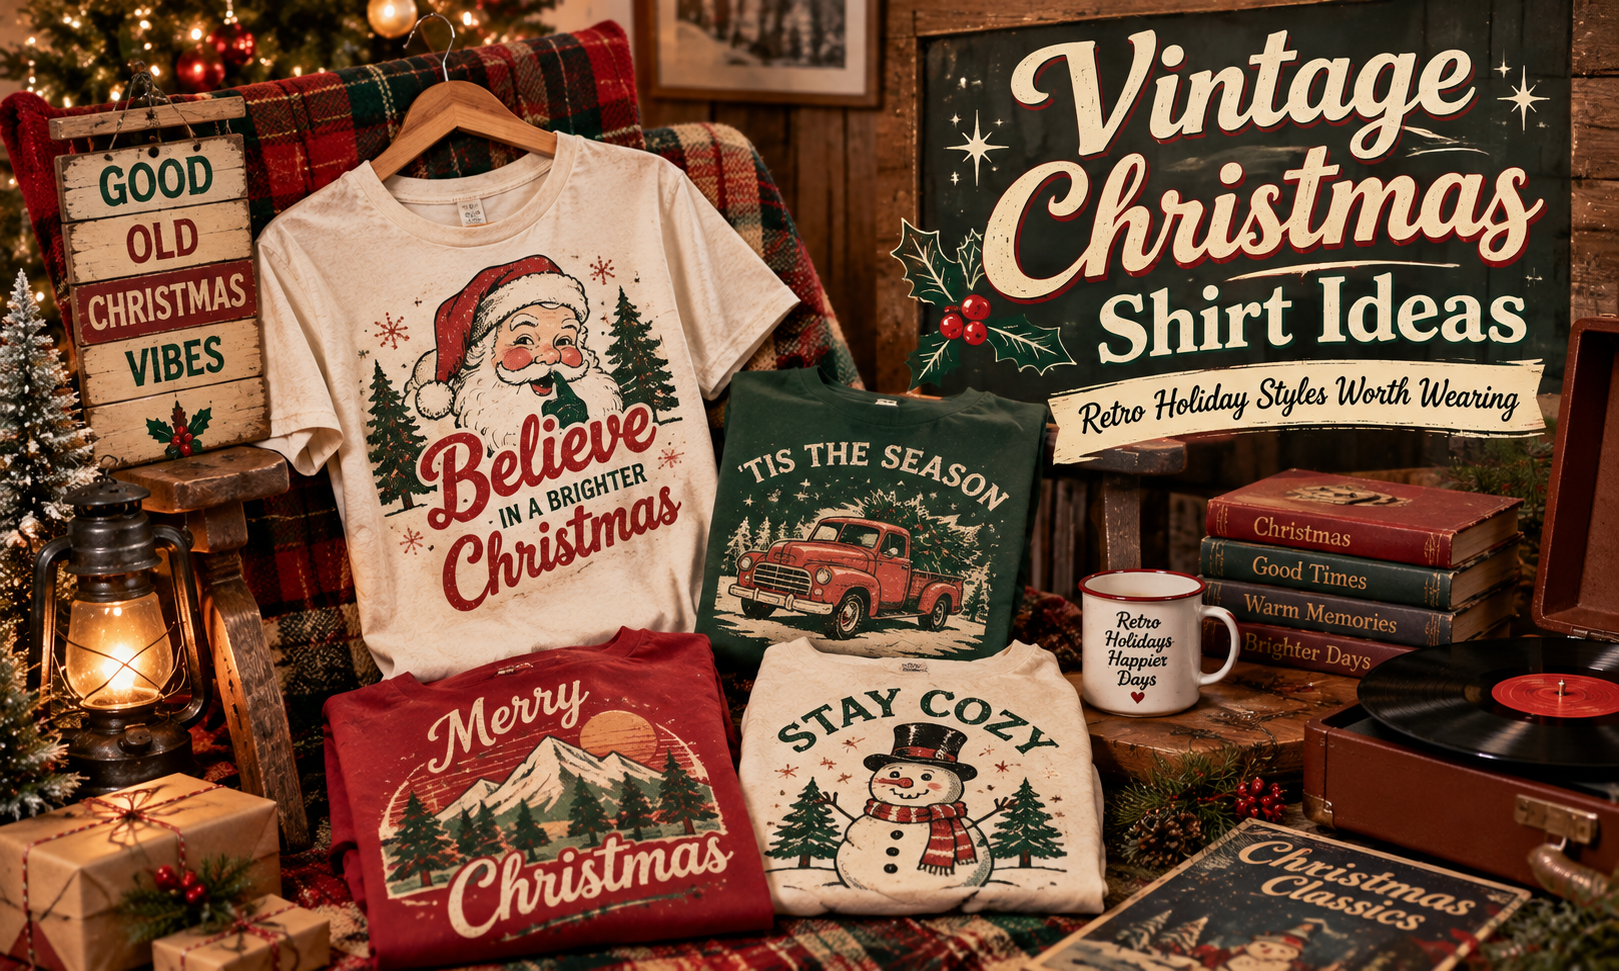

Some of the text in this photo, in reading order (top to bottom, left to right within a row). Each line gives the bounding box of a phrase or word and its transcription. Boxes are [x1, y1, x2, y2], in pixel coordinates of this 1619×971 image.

[1010, 30, 1477, 162] Vintage
[99, 155, 213, 207] GOOD
[126, 218, 199, 264] OLD
[982, 145, 1545, 301] Christmas
[88, 272, 246, 331] CHRISTMAS
[1099, 272, 1528, 365] Shirt Ideas
[125, 335, 225, 387] VIBES
[1078, 376, 1520, 435] Retro Holiday Styles Worth Wearing
[420, 406, 657, 530] Believe
[498, 462, 648, 529] IN A BRIGHTER
[738, 441, 1010, 512] 'TIS THE SEASON
[442, 486, 682, 611] Christmas
[1253, 516, 1351, 547] Christmas
[1252, 556, 1368, 591] Good Times
[1105, 630, 1173, 653] Holidays
[1116, 611, 1161, 631] Retro
[1244, 594, 1398, 634] Warm Memories
[1108, 650, 1168, 671] Happier
[1117, 670, 1157, 691] Days
[1244, 632, 1372, 672] Brighter Days
[427, 680, 590, 774] Merry
[777, 688, 1060, 755] STAY COZY
[447, 835, 734, 939] Christmas
[1237, 839, 1477, 917] Christmas
[1260, 875, 1426, 932] Classics
